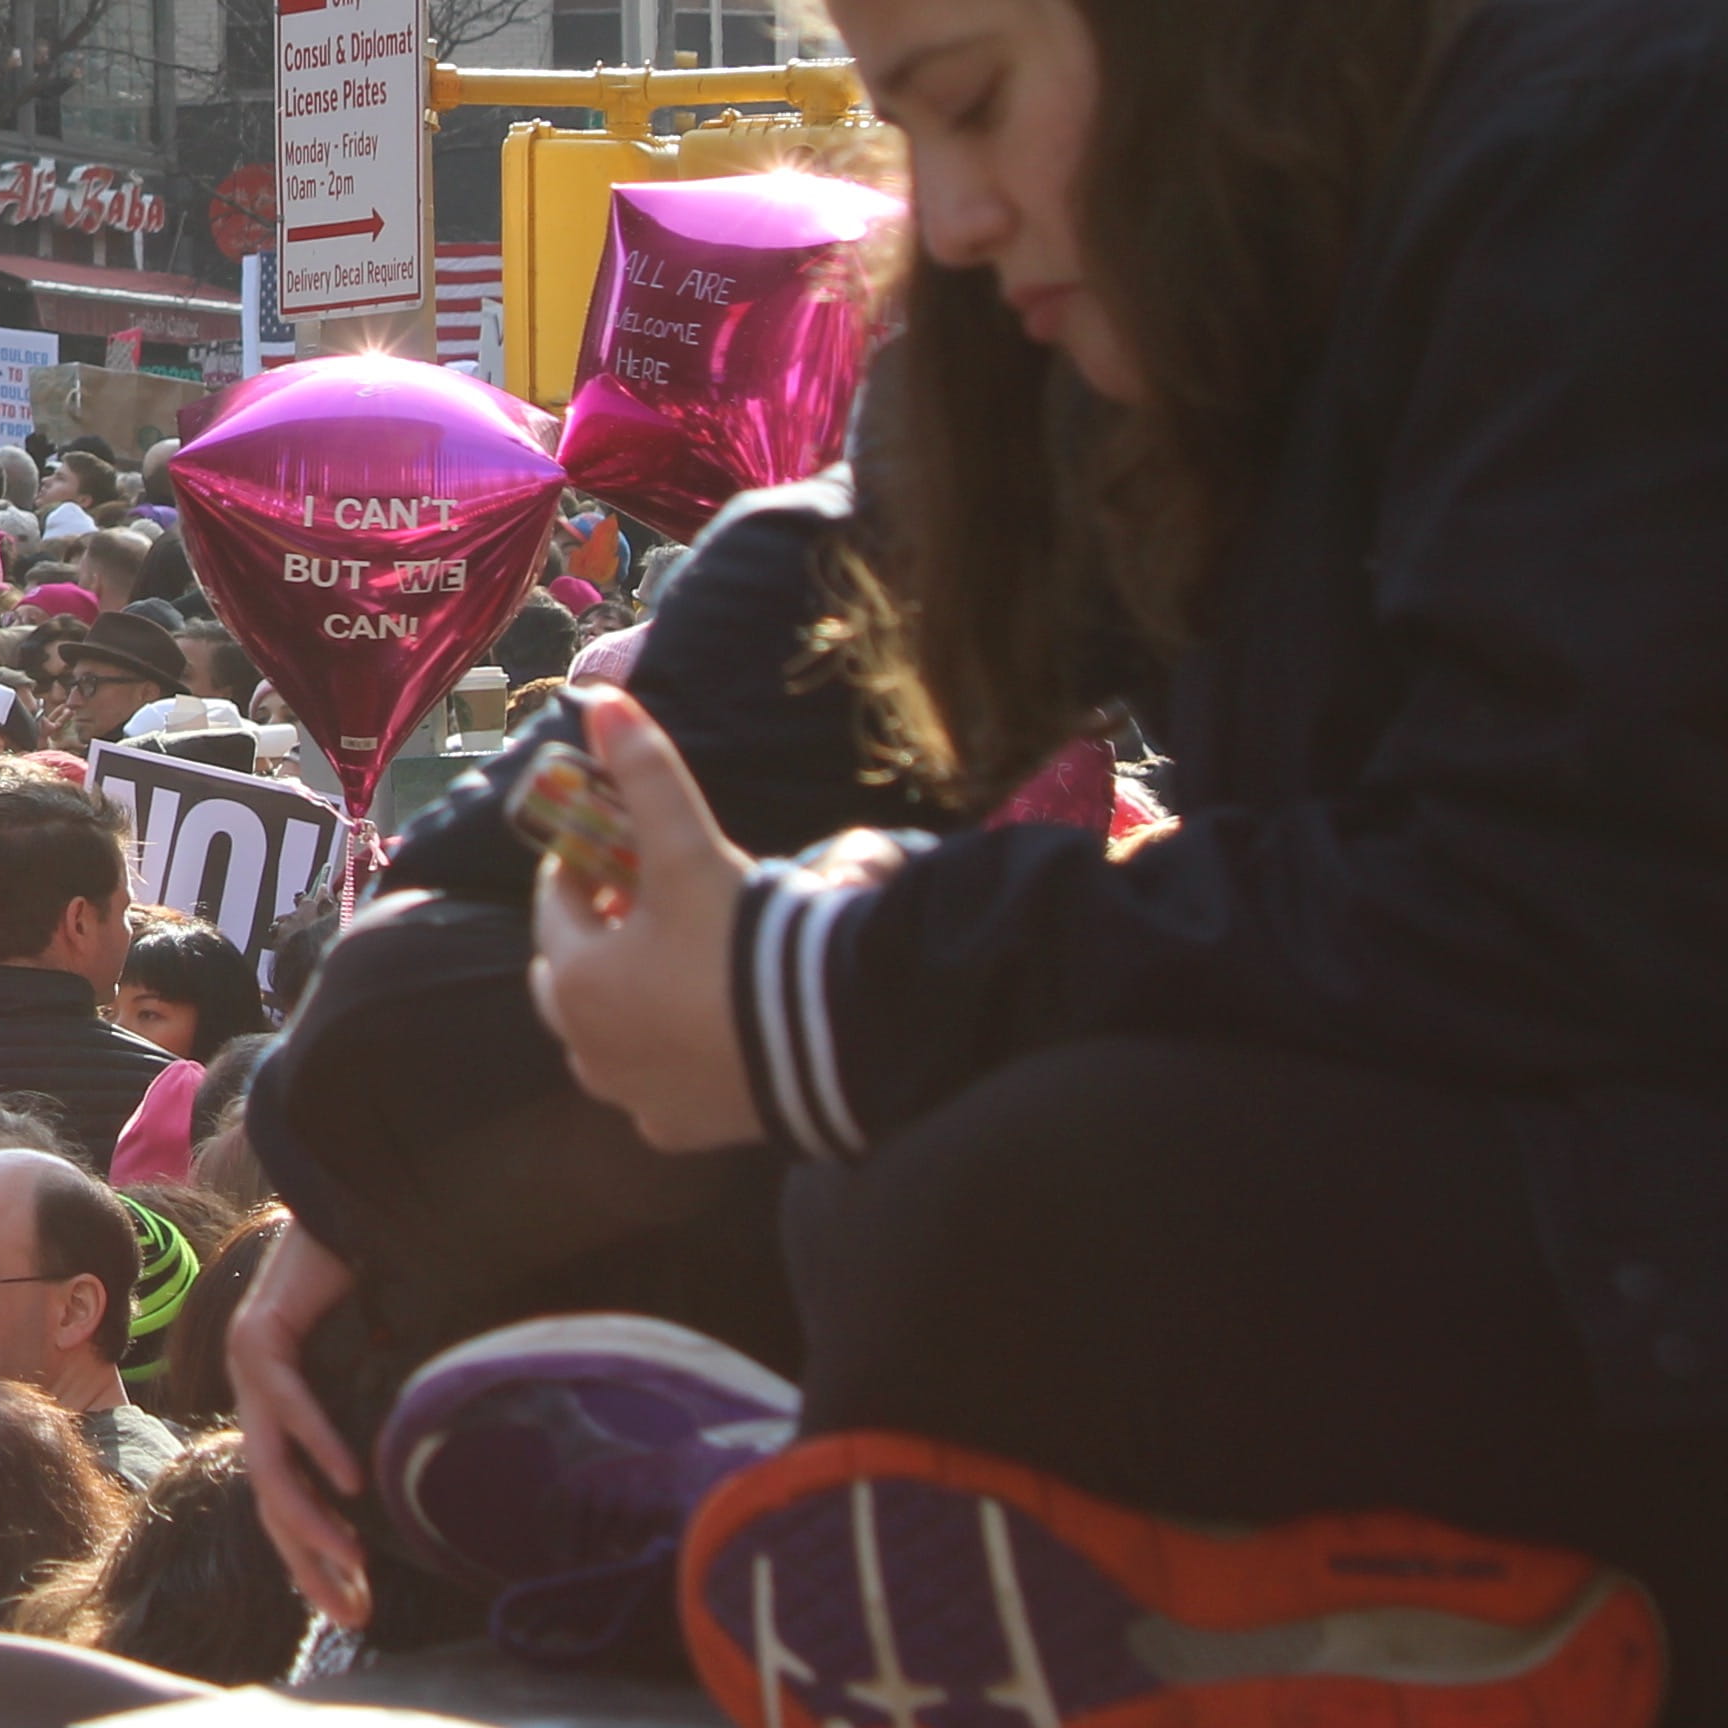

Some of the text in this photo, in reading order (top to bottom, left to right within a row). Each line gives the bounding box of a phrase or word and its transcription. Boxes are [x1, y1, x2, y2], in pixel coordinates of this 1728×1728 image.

[284, 24, 413, 72] Consul & Diplomat
[285, 77, 387, 118] License Plates
[285, 137, 330, 168] Monday
[343, 131, 378, 160] Friday
[63, 163, 165, 234] Baba
[287, 175, 316, 201] 10am
[328, 170, 355, 200] 2pm
[287, 256, 414, 294] Delivery Decal Required
[624, 250, 737, 306] ALL ARE
[8, 366, 24, 383] TO
[616, 347, 671, 385] HERE
[303, 495, 315, 528] I
[283, 553, 467, 594] BUT WE
[323, 613, 419, 642] CAN!
